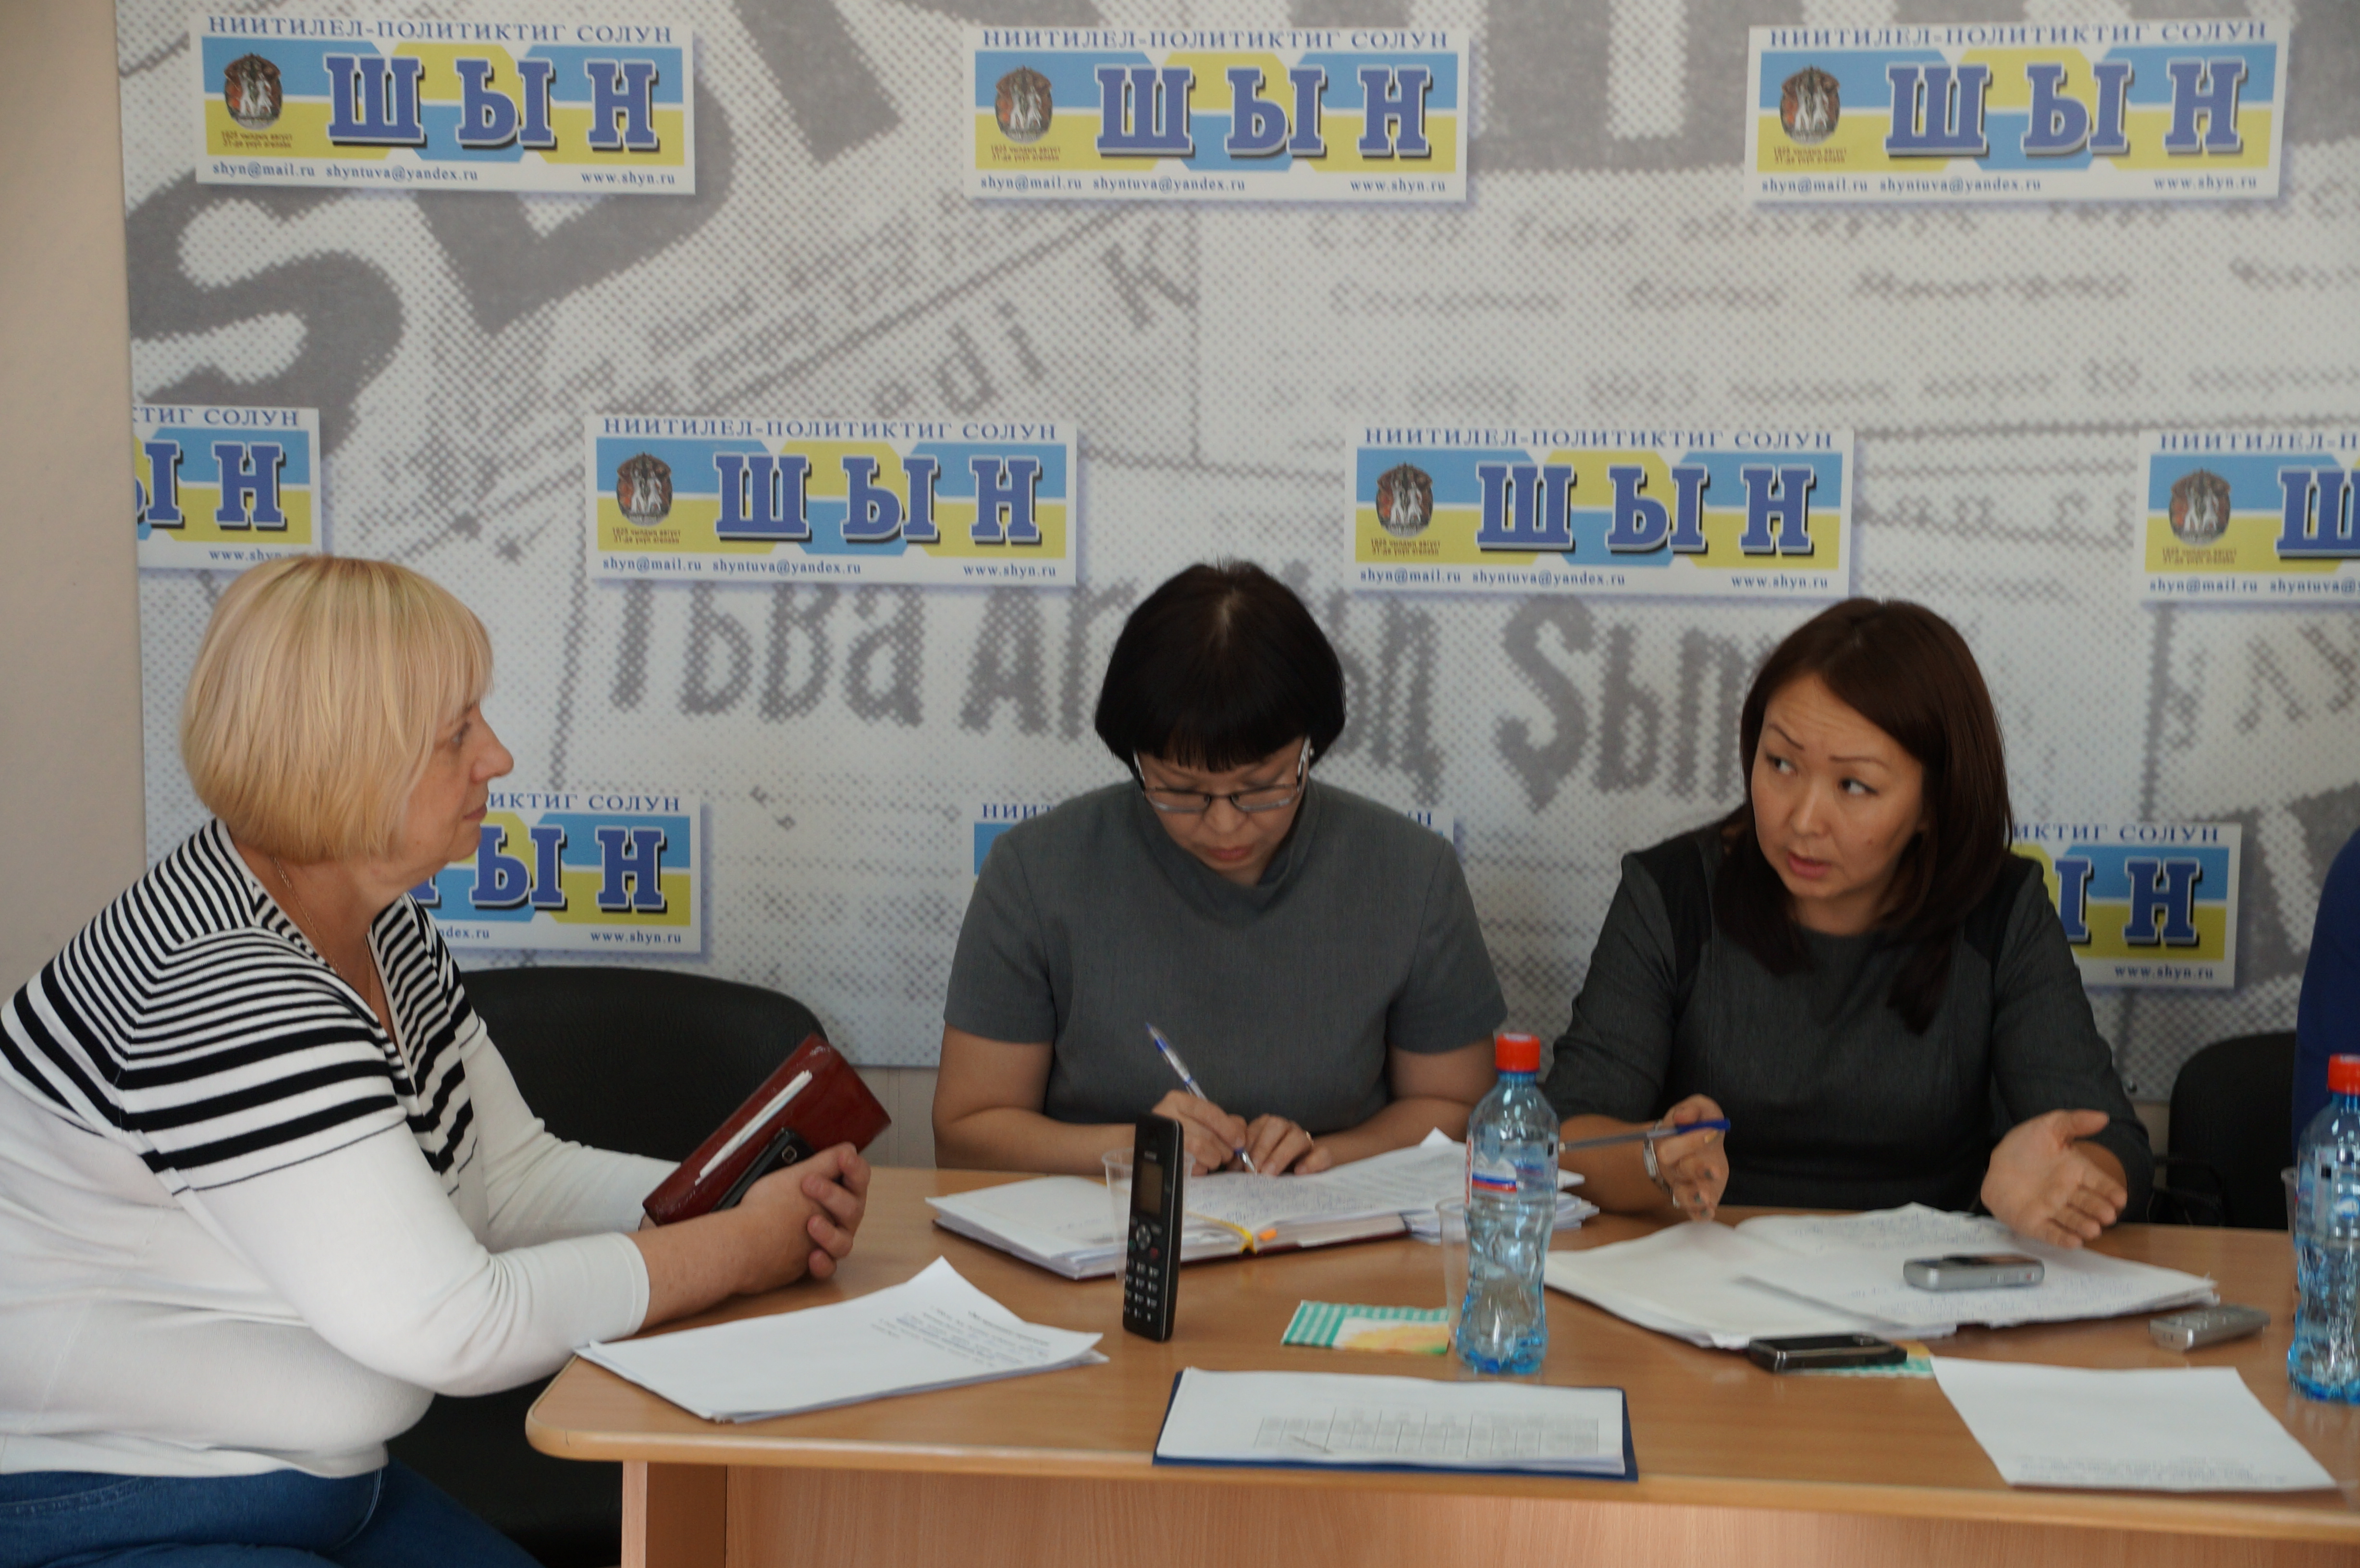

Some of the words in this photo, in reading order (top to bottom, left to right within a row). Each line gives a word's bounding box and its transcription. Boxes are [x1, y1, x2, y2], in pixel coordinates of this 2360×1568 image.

[577, 25, 672, 43] СОЛУН
[1351, 32, 1447, 48] СОЛУН
[2162, 21, 2266, 42] СОЛУН
[212, 161, 315, 178] shyn@mail.ru
[326, 164, 478, 182] shyntuva@yandex.ru
[581, 171, 675, 185] www.shyn.ru
[981, 175, 1082, 191] shyn@mail.ru
[1093, 176, 1245, 192] shyntuva@yandex.ru
[1350, 178, 1445, 192] www.shyn.ru
[1762, 177, 1868, 194] shyn@mail.ru
[1880, 177, 2040, 194] shyntuva@yandex.ru
[2154, 174, 2257, 190] www.shyn.ru
[203, 409, 298, 426] СОЛУН
[962, 424, 1056, 440] СОЛУН
[1734, 431, 1832, 449] СОЛУН
[603, 557, 701, 573] shyn@mail.ru
[713, 559, 860, 576] shyntuva@yandex.ru
[963, 564, 1056, 578] www.shyn.ru
[1360, 568, 1461, 584] shyn@mail.ru
[1473, 570, 1625, 586] shyntuva@yandex.ru
[1731, 575, 1828, 589] www.shyn.ru
[2150, 578, 2258, 594] shyn@mail.ru
[588, 795, 680, 812] СОЛУН
[2119, 826, 2218, 843] СОЛУН
[412, 825, 667, 913] ЫН
[590, 930, 681, 945] www.shyn.ru
[2114, 965, 2213, 980] www.shyn.ru
